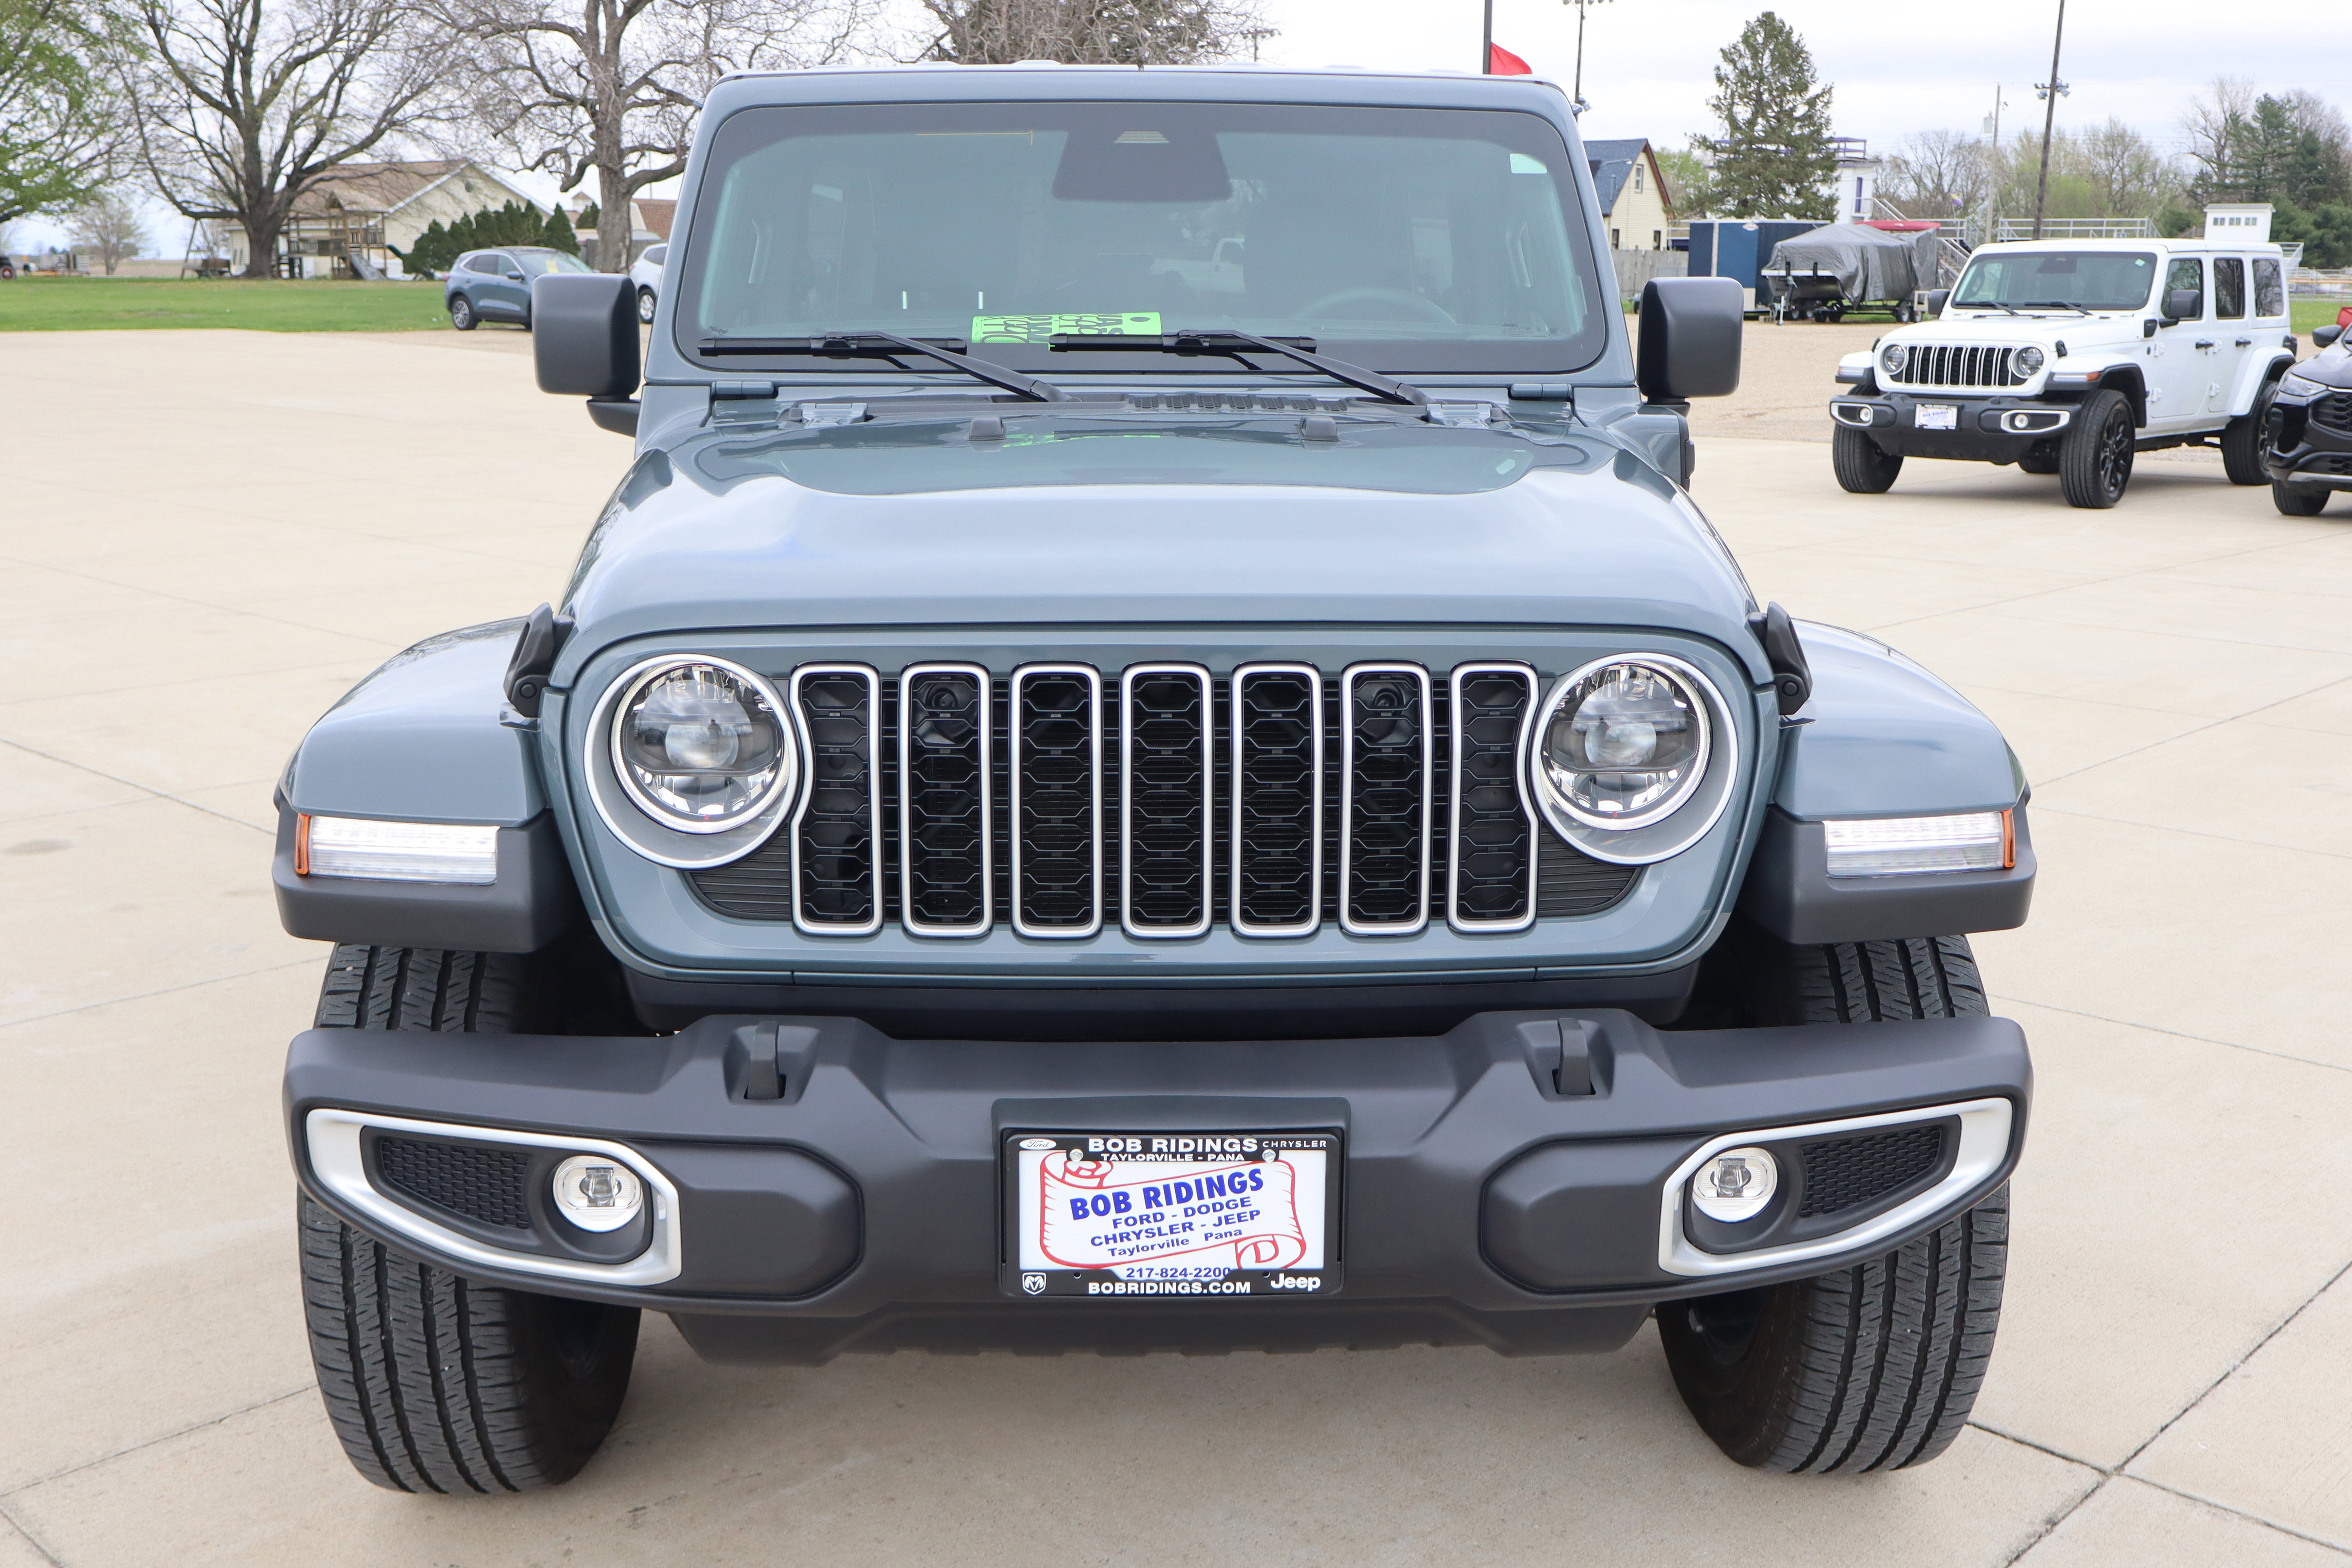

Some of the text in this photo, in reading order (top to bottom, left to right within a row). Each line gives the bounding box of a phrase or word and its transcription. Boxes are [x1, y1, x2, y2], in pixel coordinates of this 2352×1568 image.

[1027, 1140, 1049, 1148] Ford
[1089, 1138, 1258, 1153] BOB RIDINGS
[1070, 1168, 1263, 1220] BOB RIDINGS
[1112, 1212, 1165, 1229] FORD
[1184, 1196, 1252, 1217] DODGE
[1091, 1221, 1195, 1246] CHRYSLER
[1213, 1209, 1261, 1227] JEEP
[1107, 1228, 1242, 1257] Taylorville Pana
[1126, 1267, 1231, 1278] 217-824-2200
[1088, 1282, 1251, 1294] BOBRIDINGS.COM
[1270, 1273, 1321, 1292] Jeep
